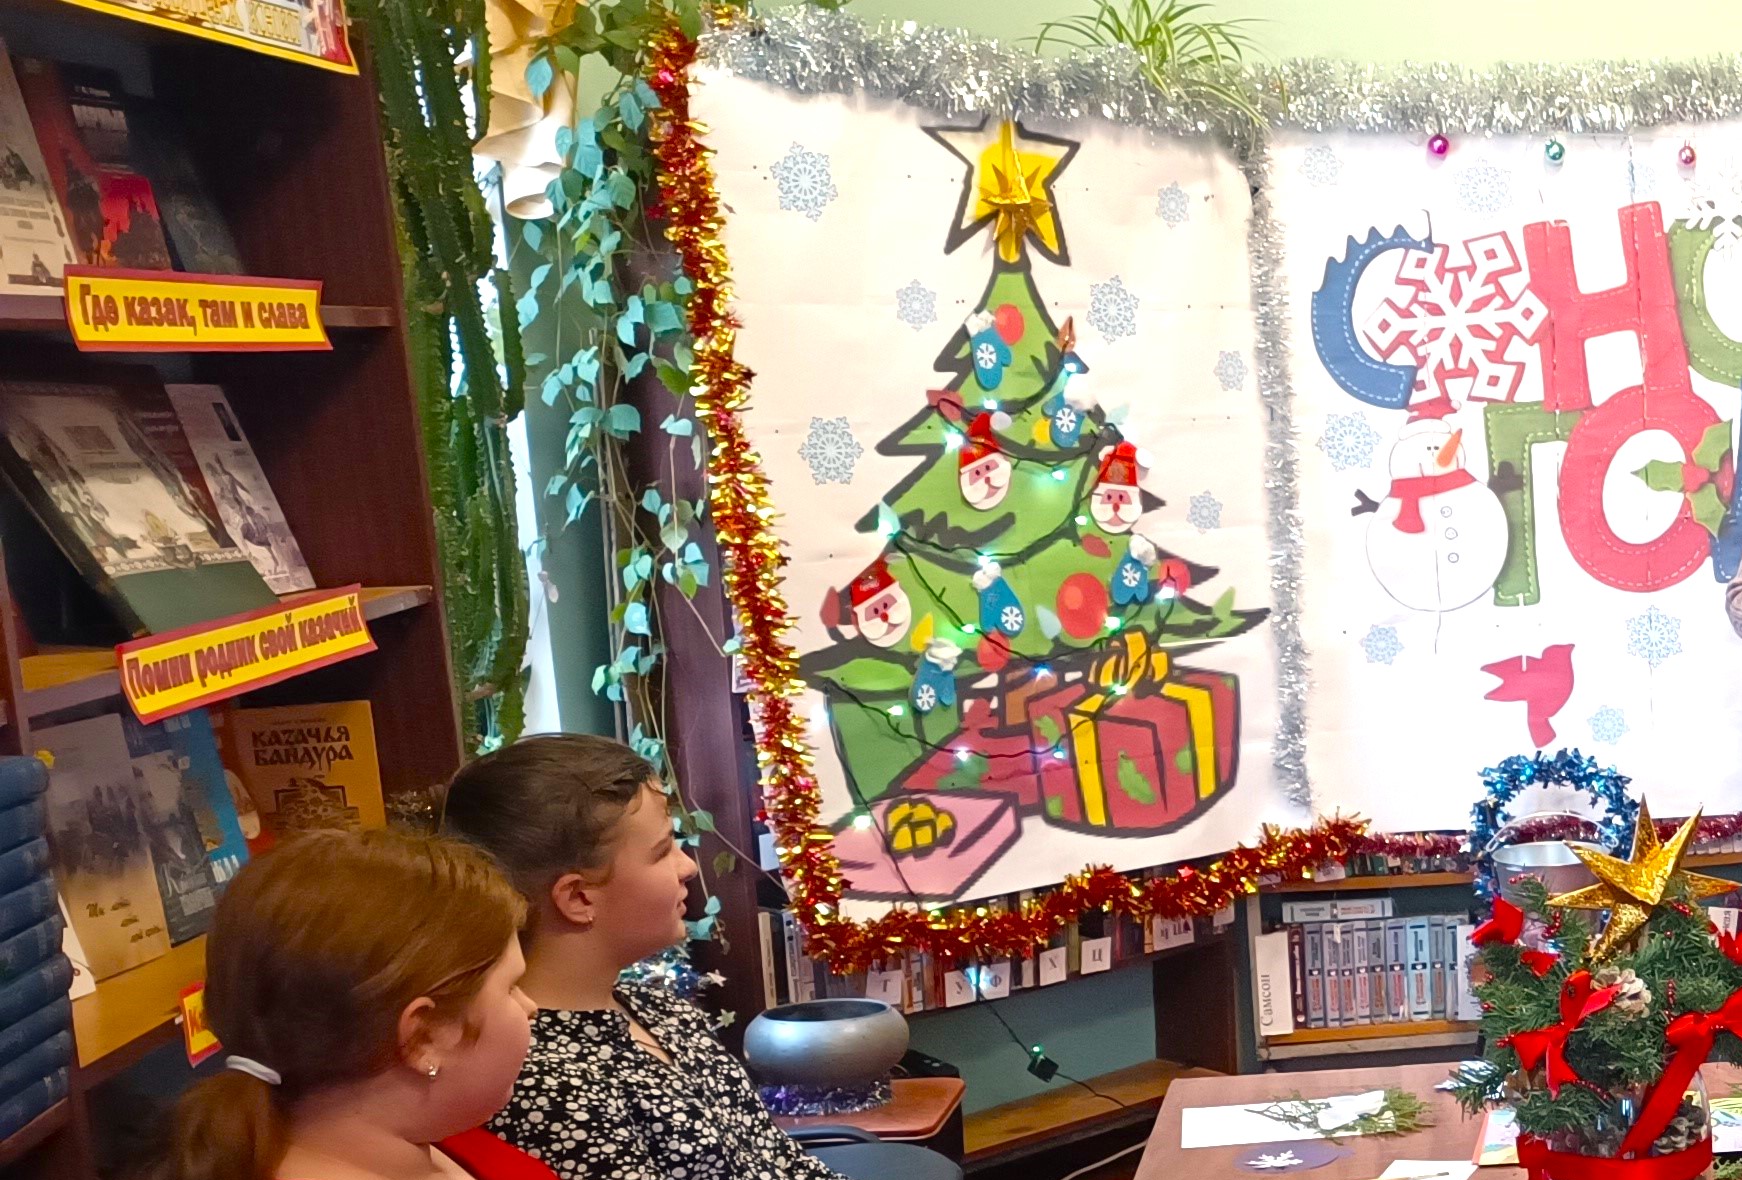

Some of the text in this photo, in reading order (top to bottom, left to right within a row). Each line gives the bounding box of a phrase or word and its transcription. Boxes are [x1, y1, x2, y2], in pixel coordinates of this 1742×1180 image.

[79, 284, 310, 336] Где казак, там и слава
[126, 596, 364, 700] Помни родник свой казачий
[254, 744, 355, 772] БАНДУРА
